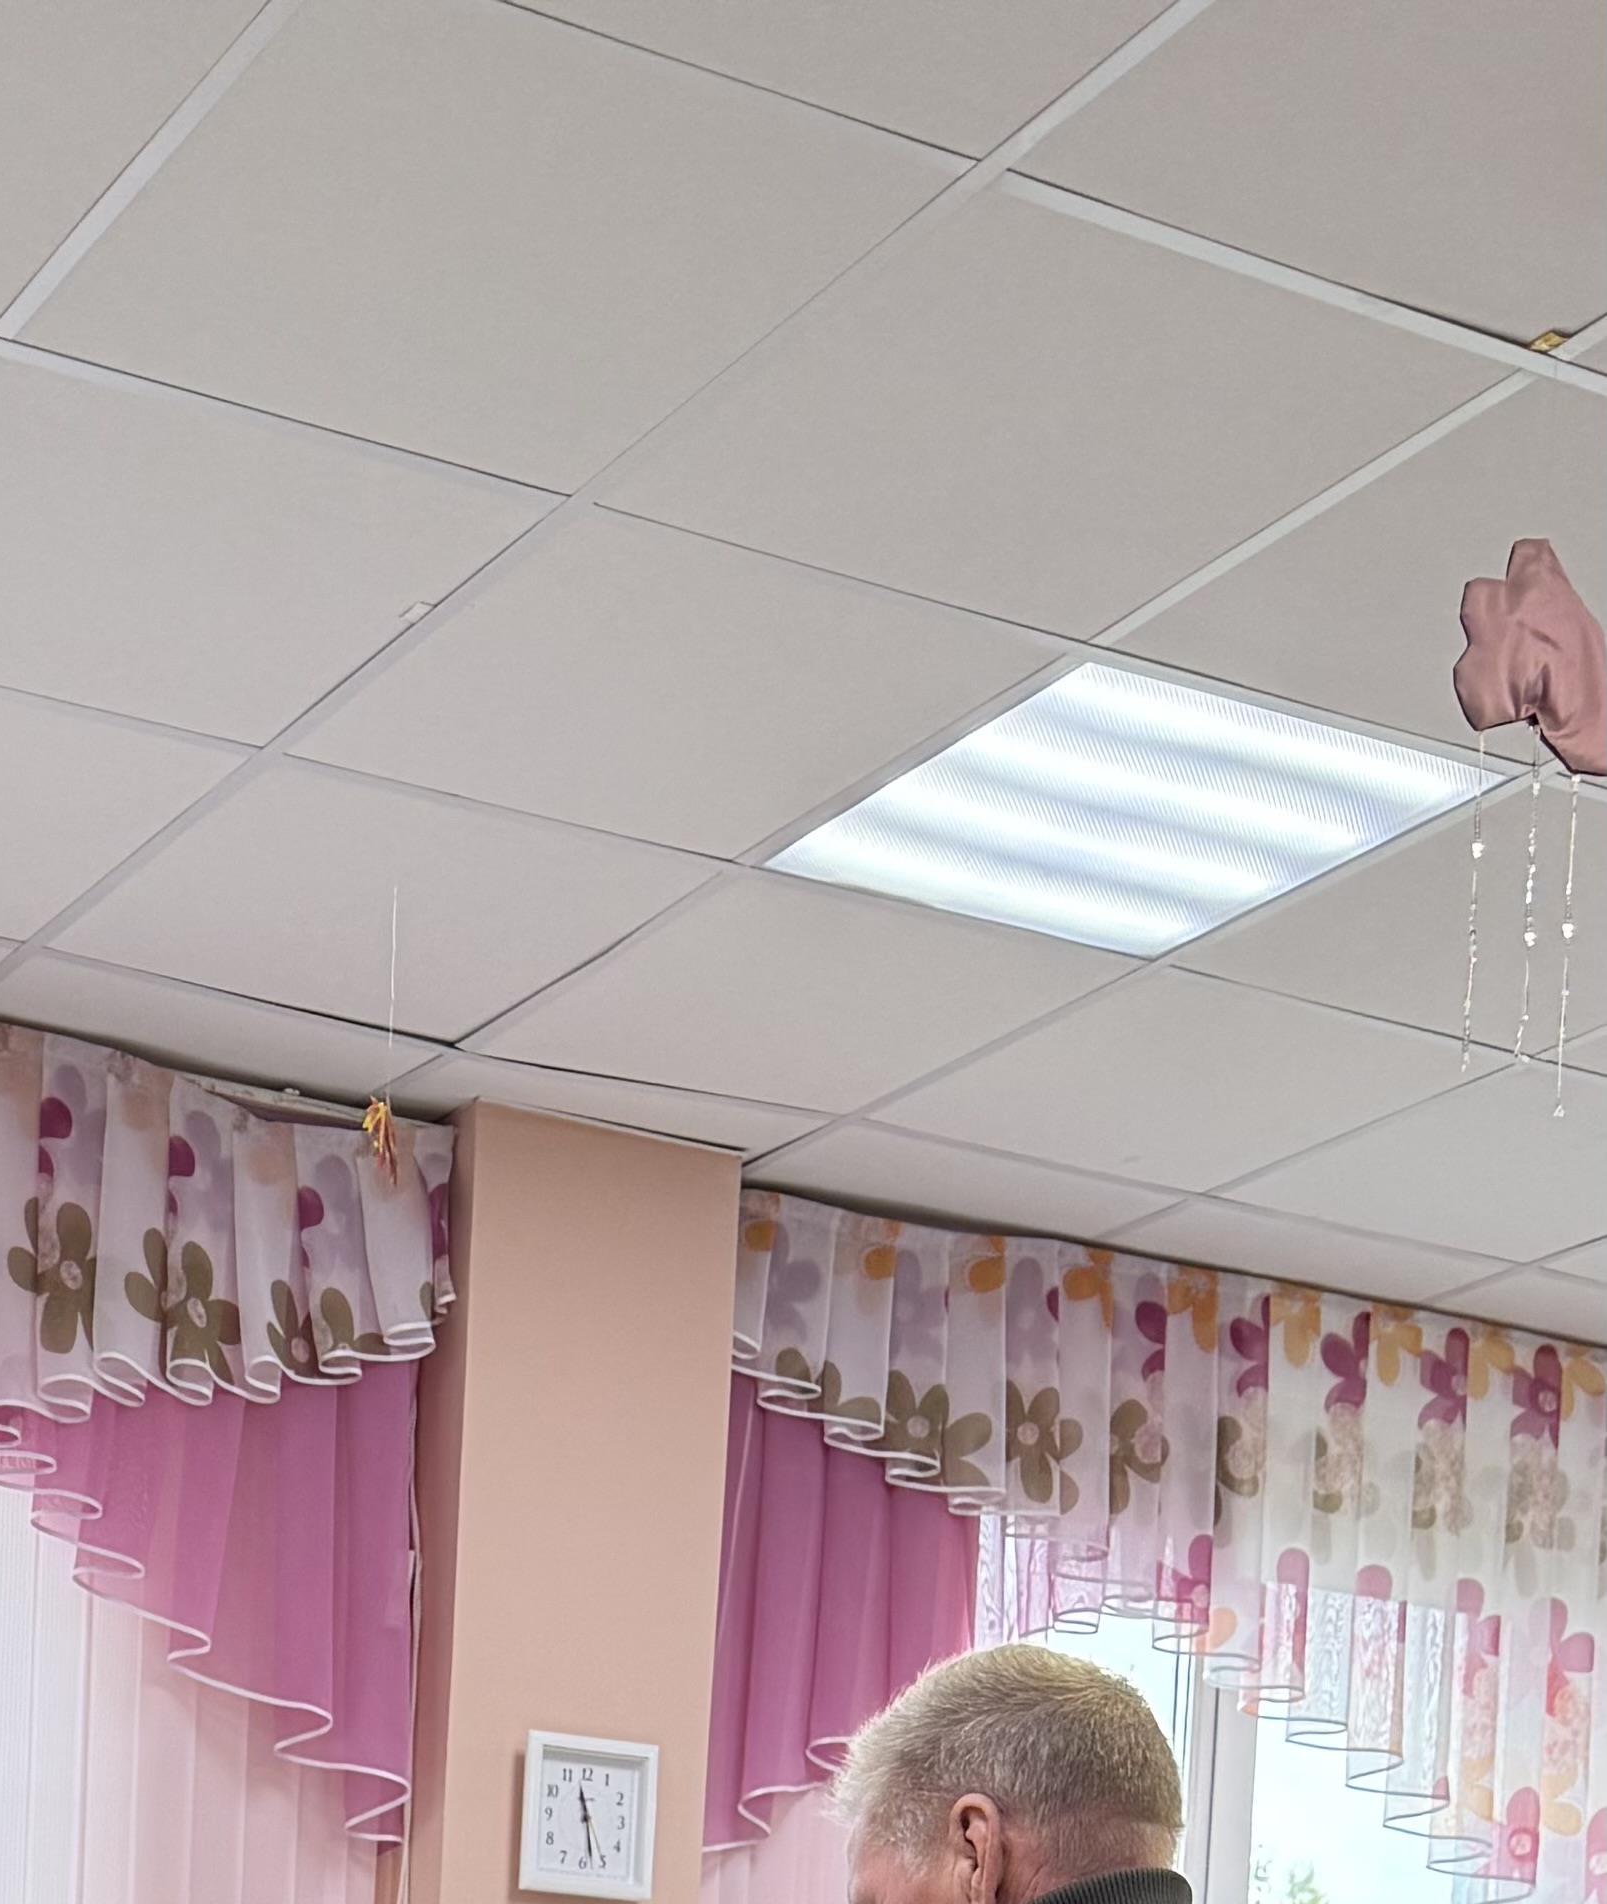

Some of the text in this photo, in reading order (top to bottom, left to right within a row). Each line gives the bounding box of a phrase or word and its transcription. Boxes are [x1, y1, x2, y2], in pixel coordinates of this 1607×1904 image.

[562, 1767, 573, 1784] 11
[581, 1767, 594, 1782] 12
[603, 1773, 611, 1787] 1
[546, 1783, 560, 1799] 10
[615, 1791, 625, 1807] 2
[544, 1807, 554, 1821] 9
[617, 1815, 626, 1831] 3
[545, 1831, 555, 1846] 8
[612, 1839, 622, 1854] 4
[559, 1850, 568, 1865] 7
[578, 1855, 588, 1870] 6
